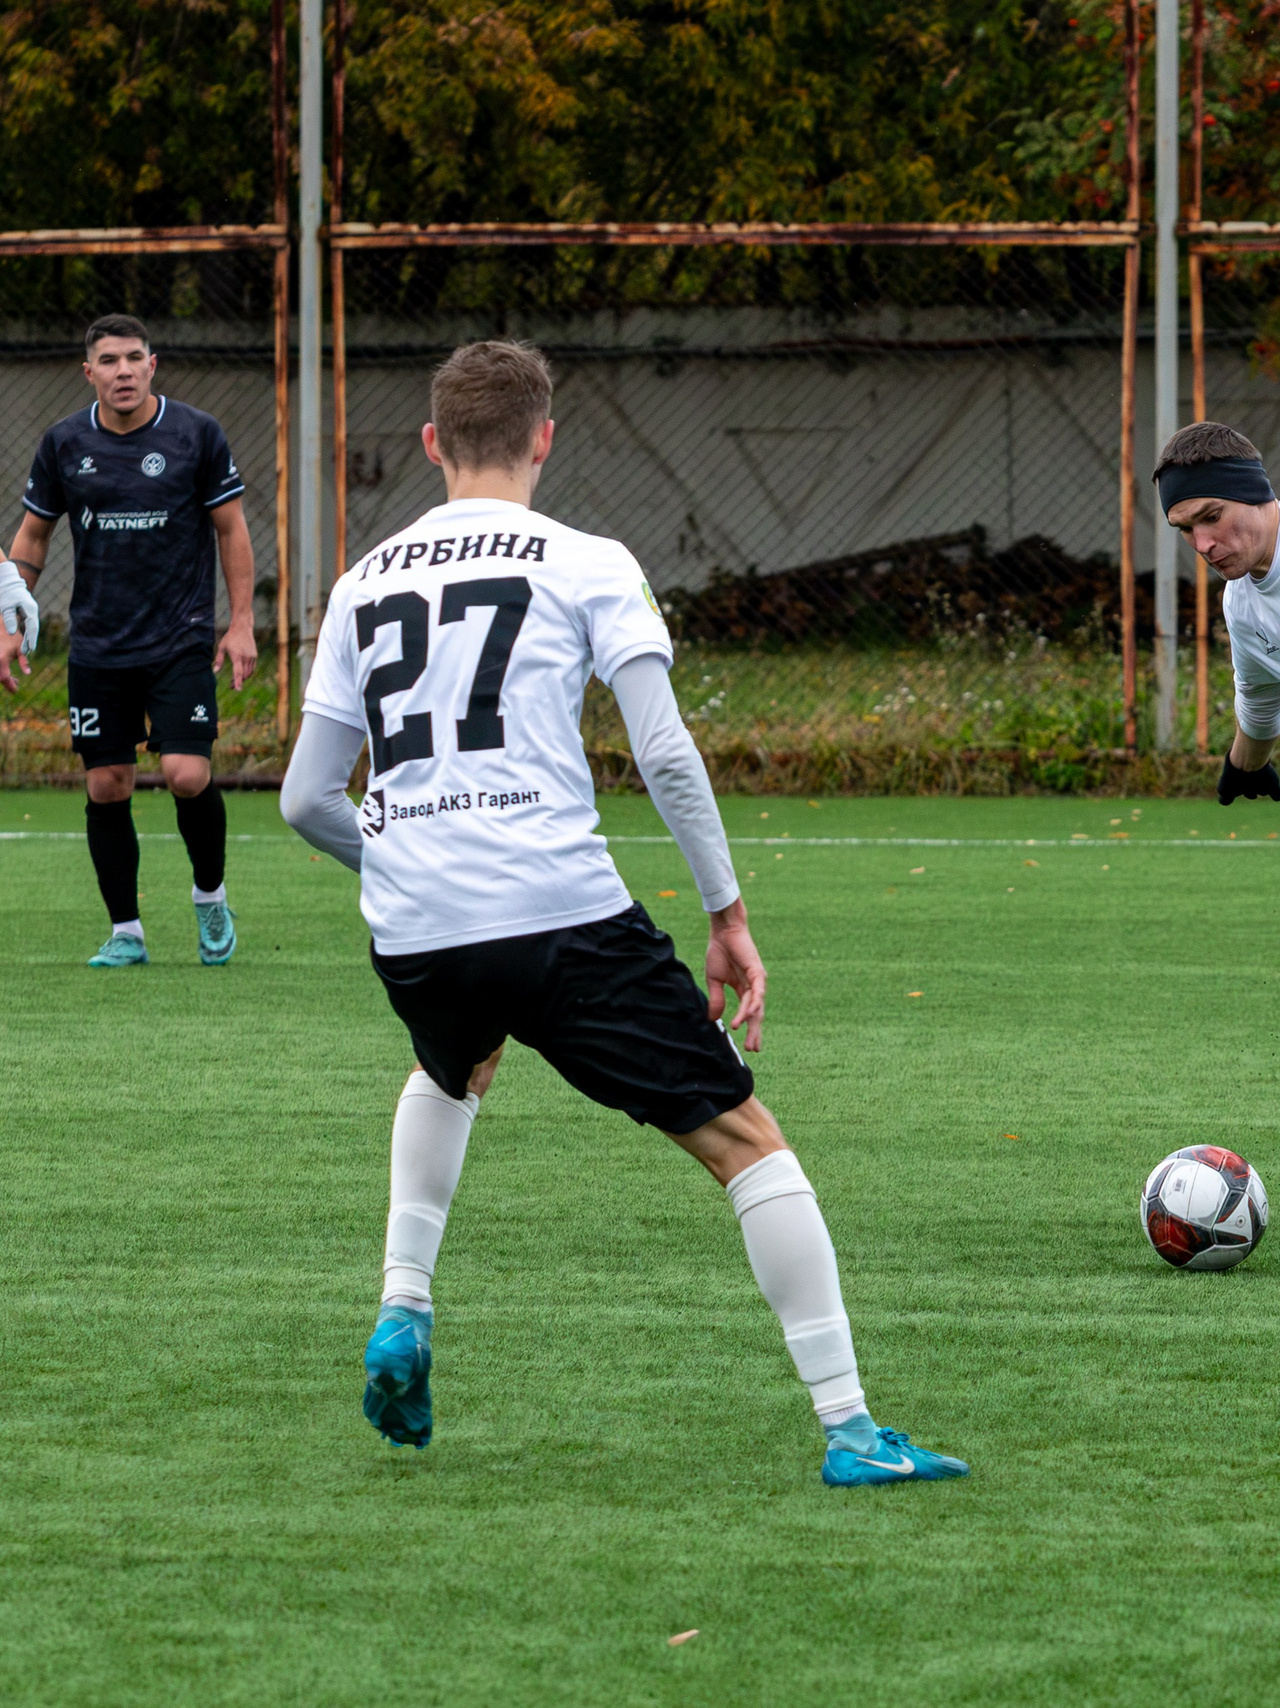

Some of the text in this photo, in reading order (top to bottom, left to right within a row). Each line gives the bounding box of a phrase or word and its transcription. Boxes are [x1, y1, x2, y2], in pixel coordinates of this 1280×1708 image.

[98, 517, 168, 530] TATNEFT
[359, 533, 547, 581] ТУРБИНА
[355, 576, 533, 777] 27
[390, 802, 435, 820] Завод
[478, 791, 540, 809] Гарант
